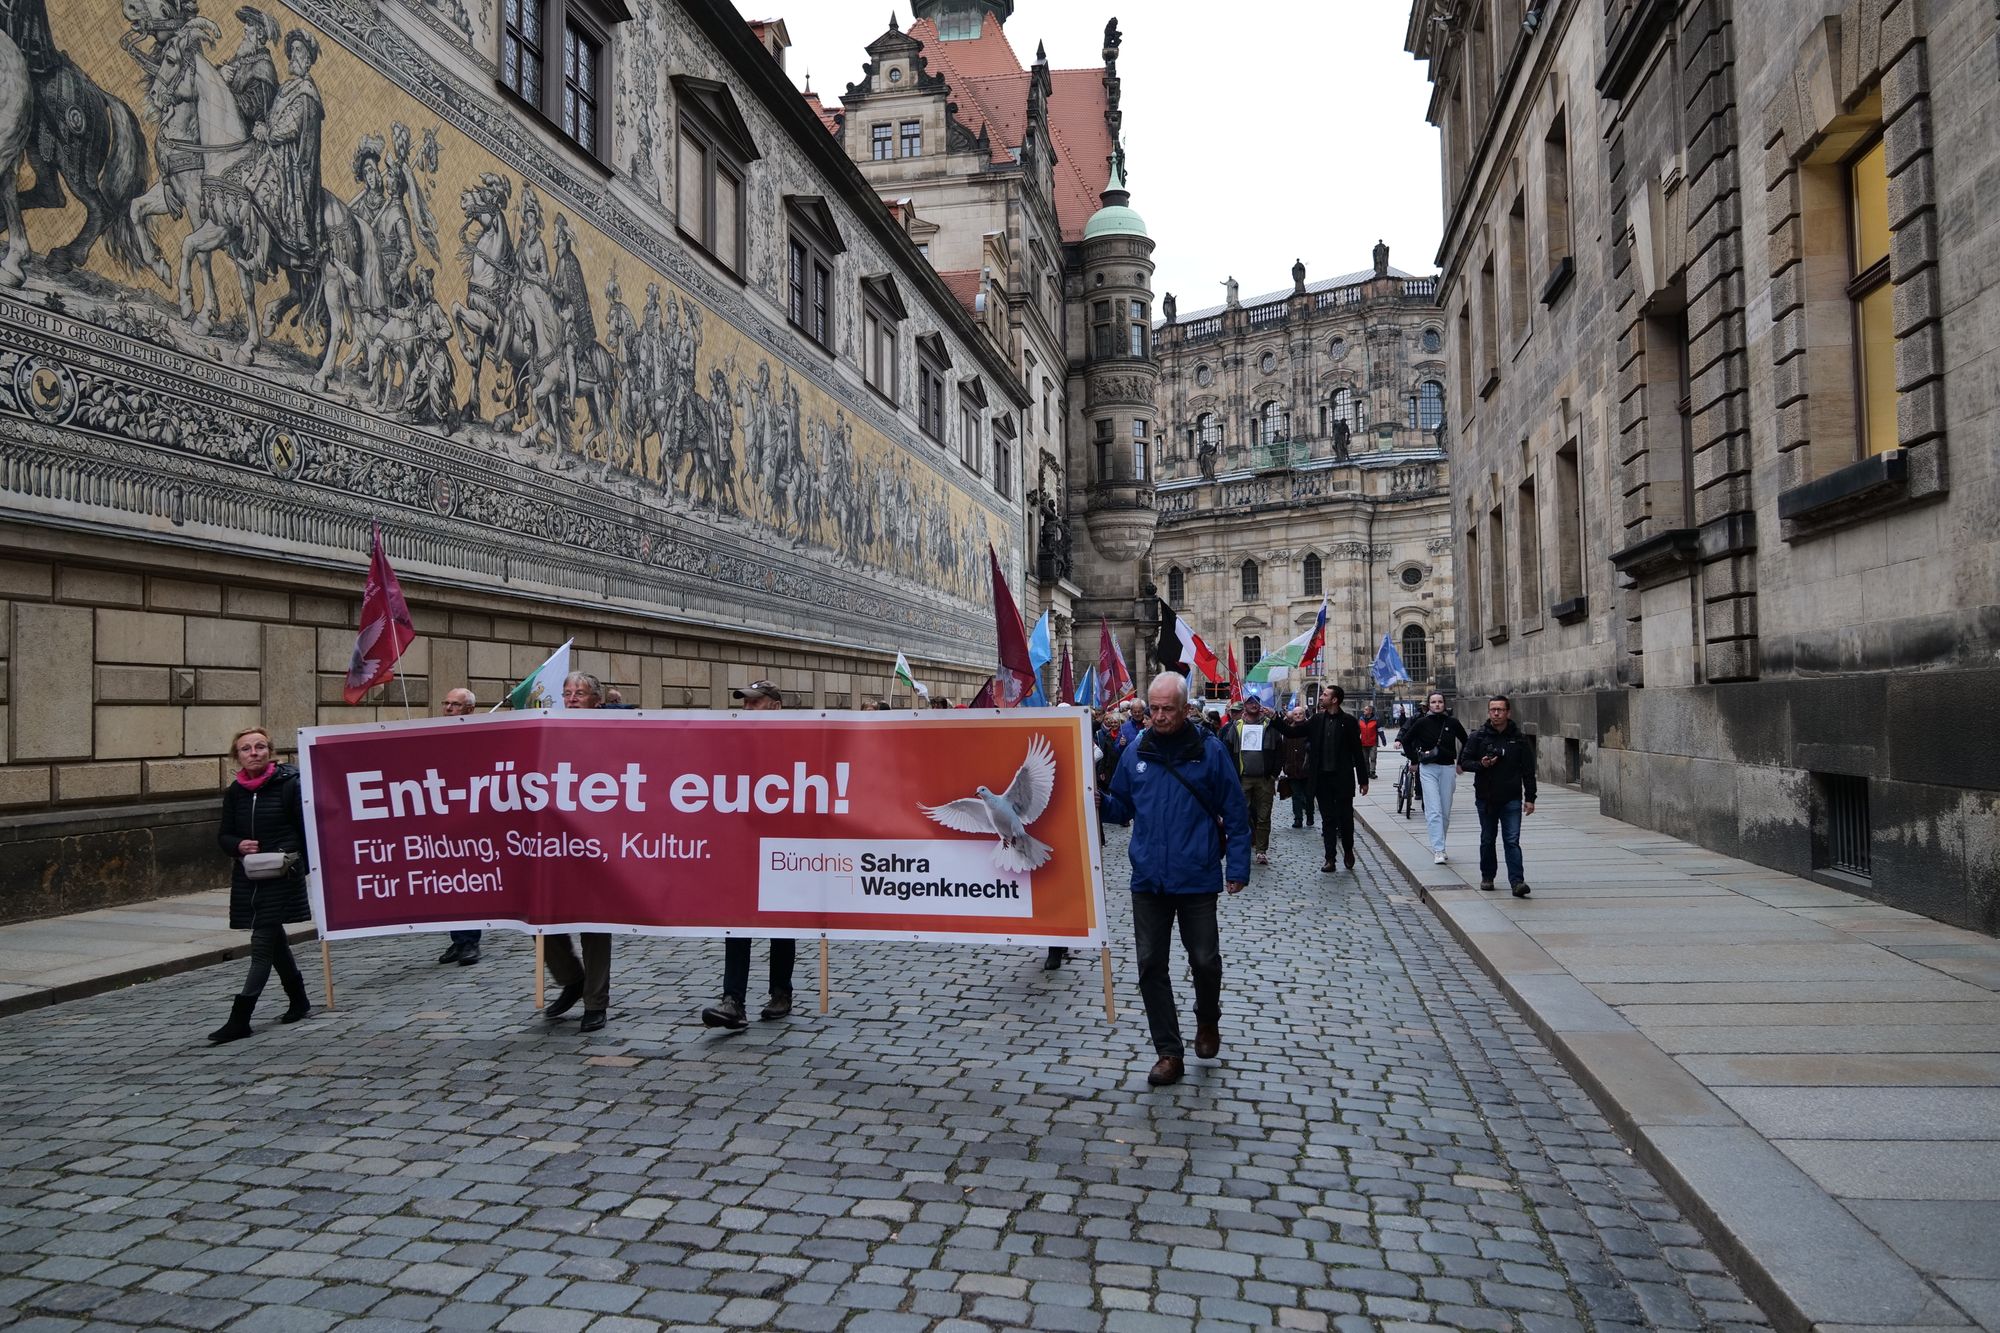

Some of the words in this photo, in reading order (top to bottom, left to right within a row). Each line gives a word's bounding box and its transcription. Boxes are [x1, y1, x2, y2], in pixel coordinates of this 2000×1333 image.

[53, 319, 65, 335] D.
[68, 325, 181, 370] GROSSMUETHIGE
[195, 365, 237, 388] GEORG
[240, 379, 250, 392] D.
[317, 404, 361, 427] HEINRICH
[364, 419, 372, 430] D.
[347, 761, 646, 820] Ent-rüstet
[669, 762, 850, 814] euch!
[354, 839, 395, 865] Für
[404, 835, 500, 862] Bildung,
[506, 831, 609, 863] Soziales,
[621, 833, 711, 859] Kultur.
[771, 851, 853, 873] Bündnis
[861, 853, 930, 874] Sahra
[357, 873, 400, 900] Für
[408, 867, 503, 896] Frieden!
[860, 876, 1020, 901] Wagenknecht
